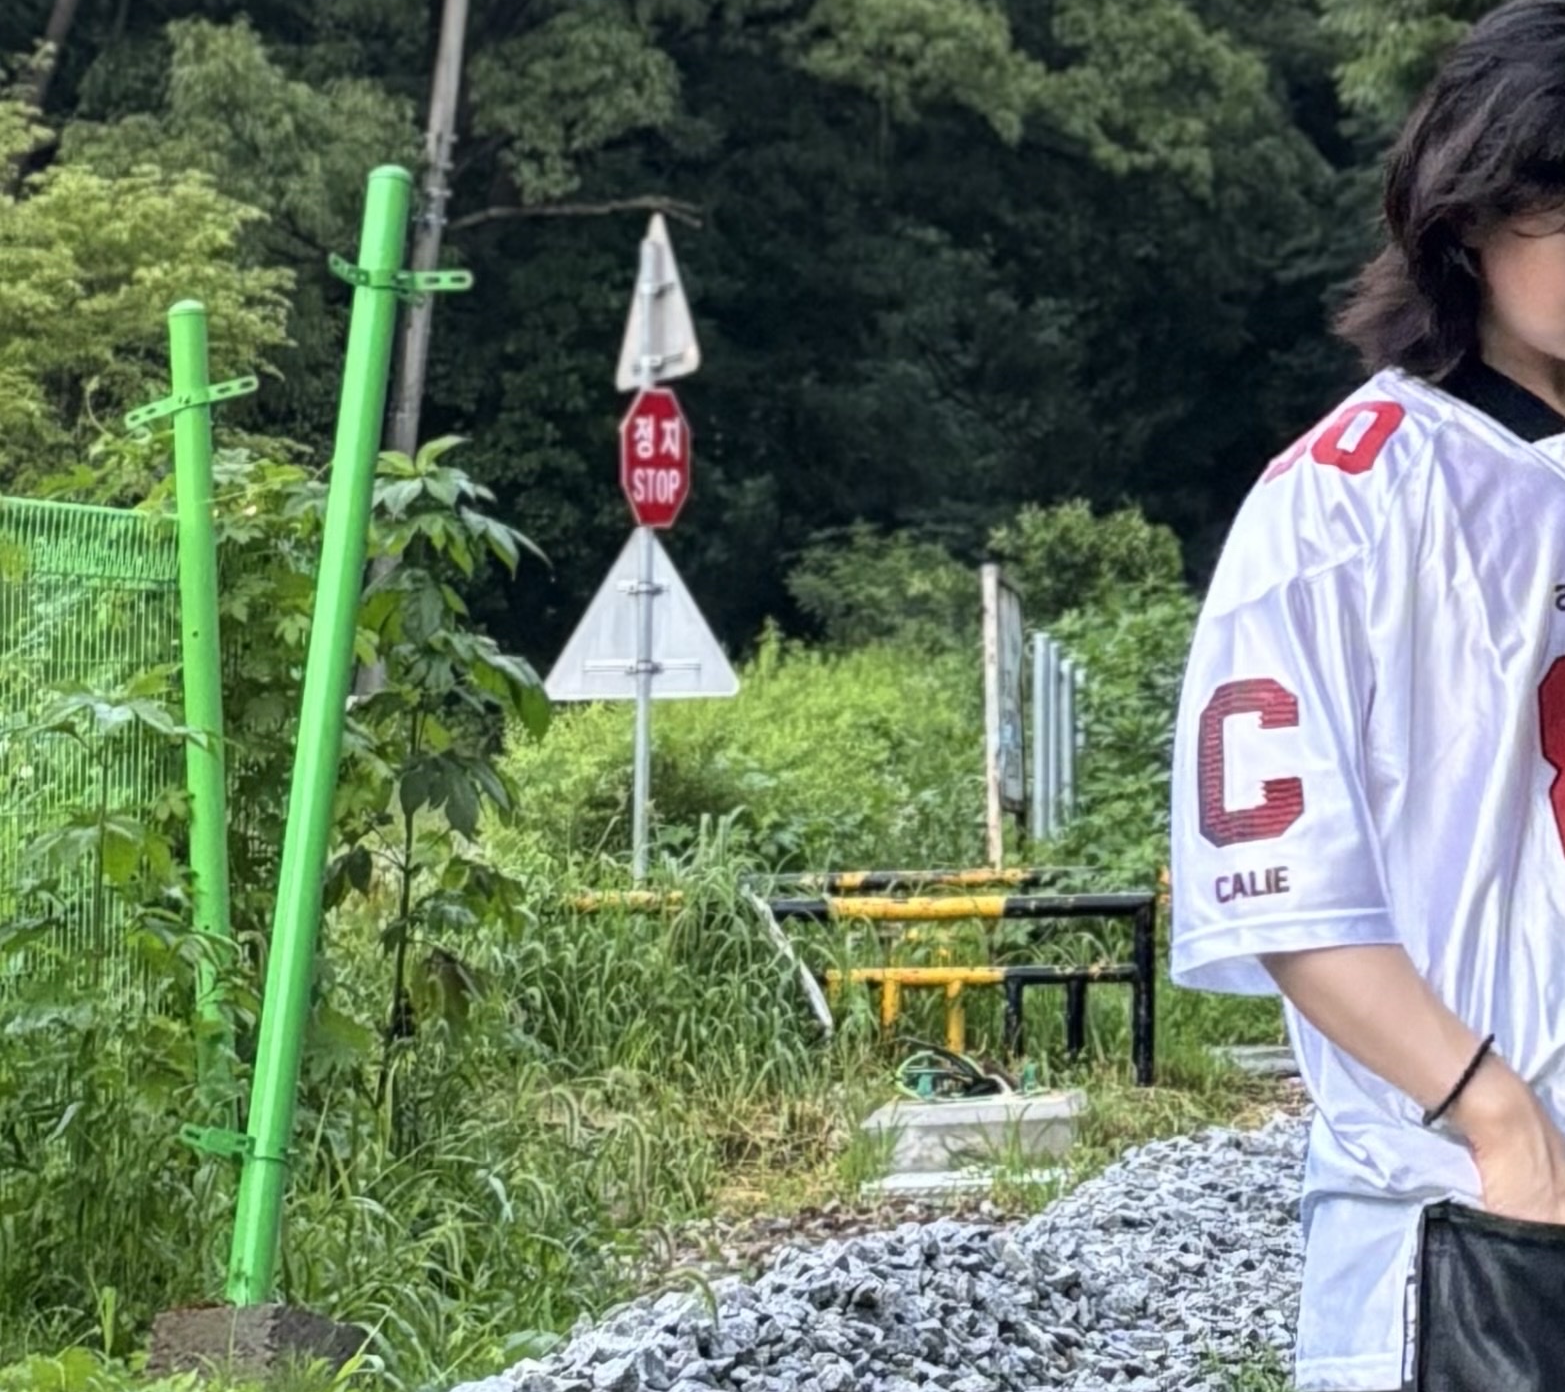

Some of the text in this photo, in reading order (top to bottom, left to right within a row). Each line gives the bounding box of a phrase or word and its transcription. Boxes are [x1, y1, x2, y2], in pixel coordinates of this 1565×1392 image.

[633, 414, 681, 459] 정지
[633, 469, 681, 504] STOP
[1197, 678, 1305, 848] C
[1214, 866, 1291, 904] CALIE
